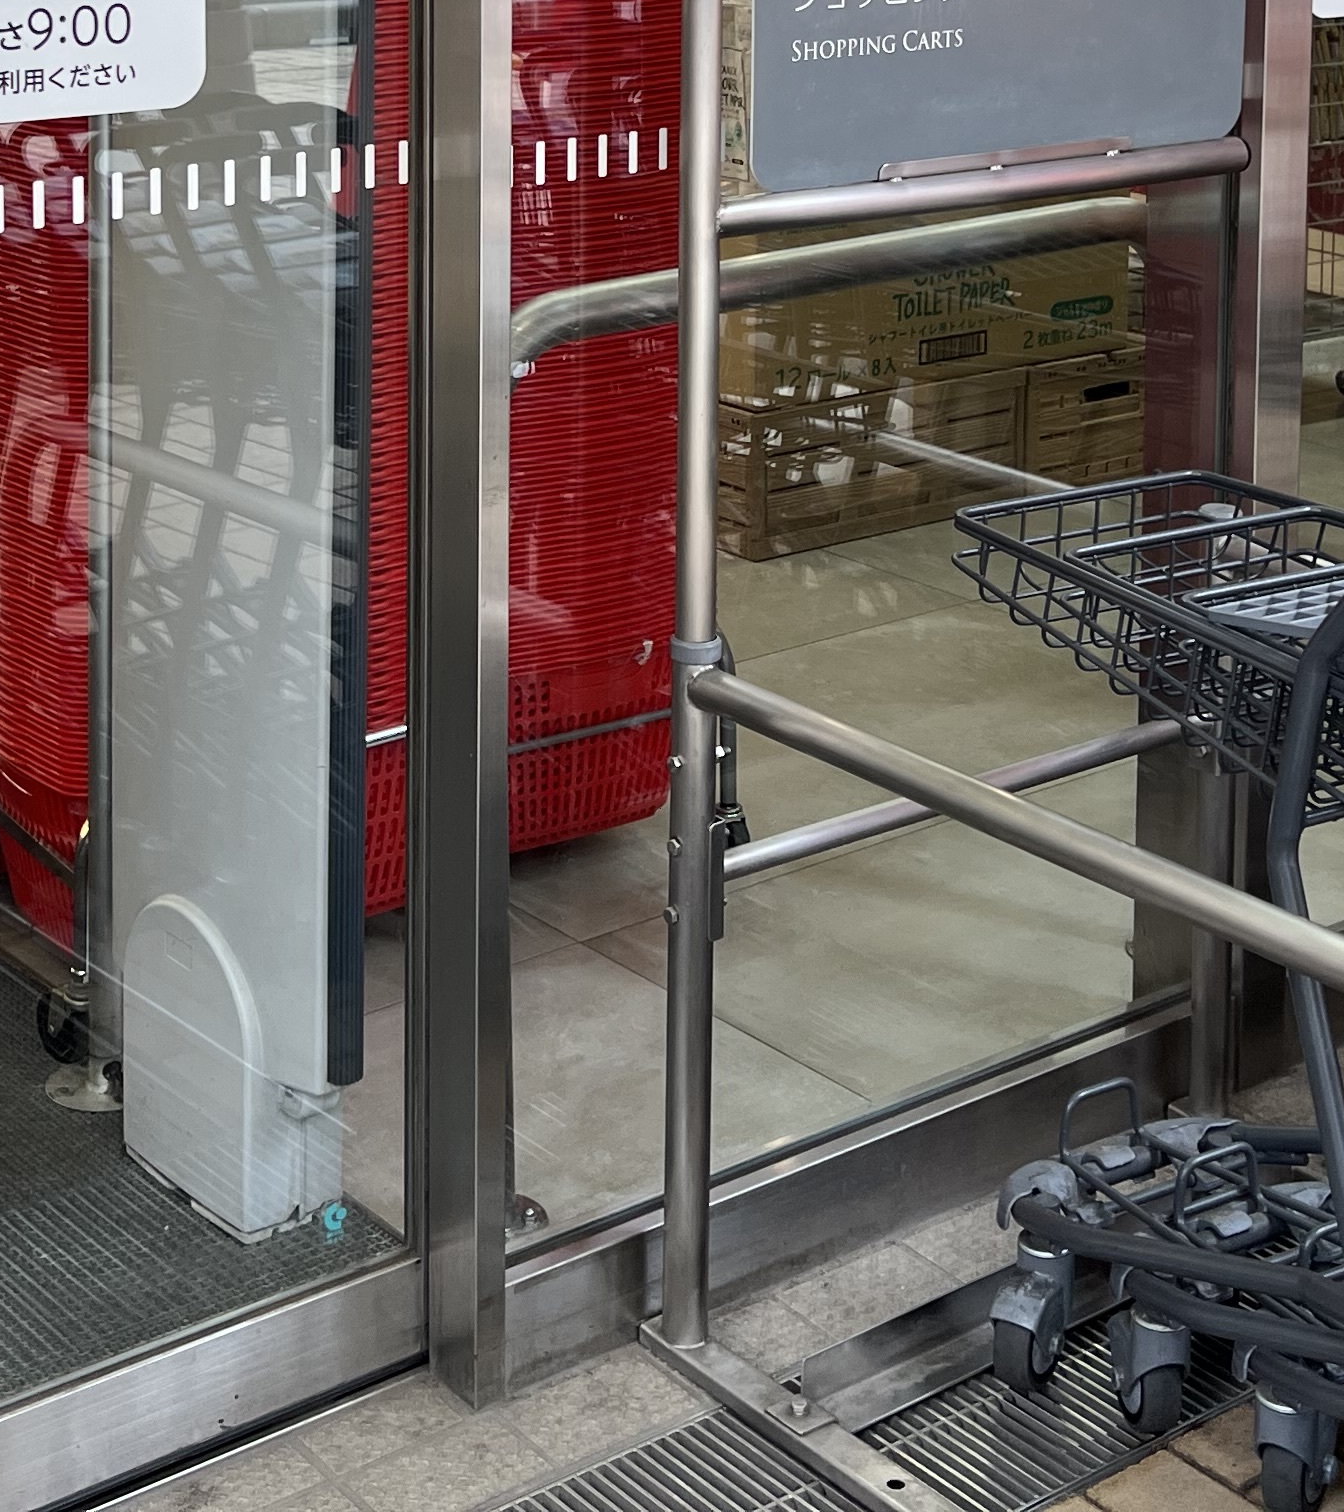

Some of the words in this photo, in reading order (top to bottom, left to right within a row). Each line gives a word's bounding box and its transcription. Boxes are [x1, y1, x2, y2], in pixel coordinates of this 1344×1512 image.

[791, 32, 897, 64] SHOPPING
[902, 28, 964, 54] CARTS
[891, 287, 957, 322] TOILET
[958, 276, 1016, 315] PAPER
[1076, 319, 1114, 340] 23m
